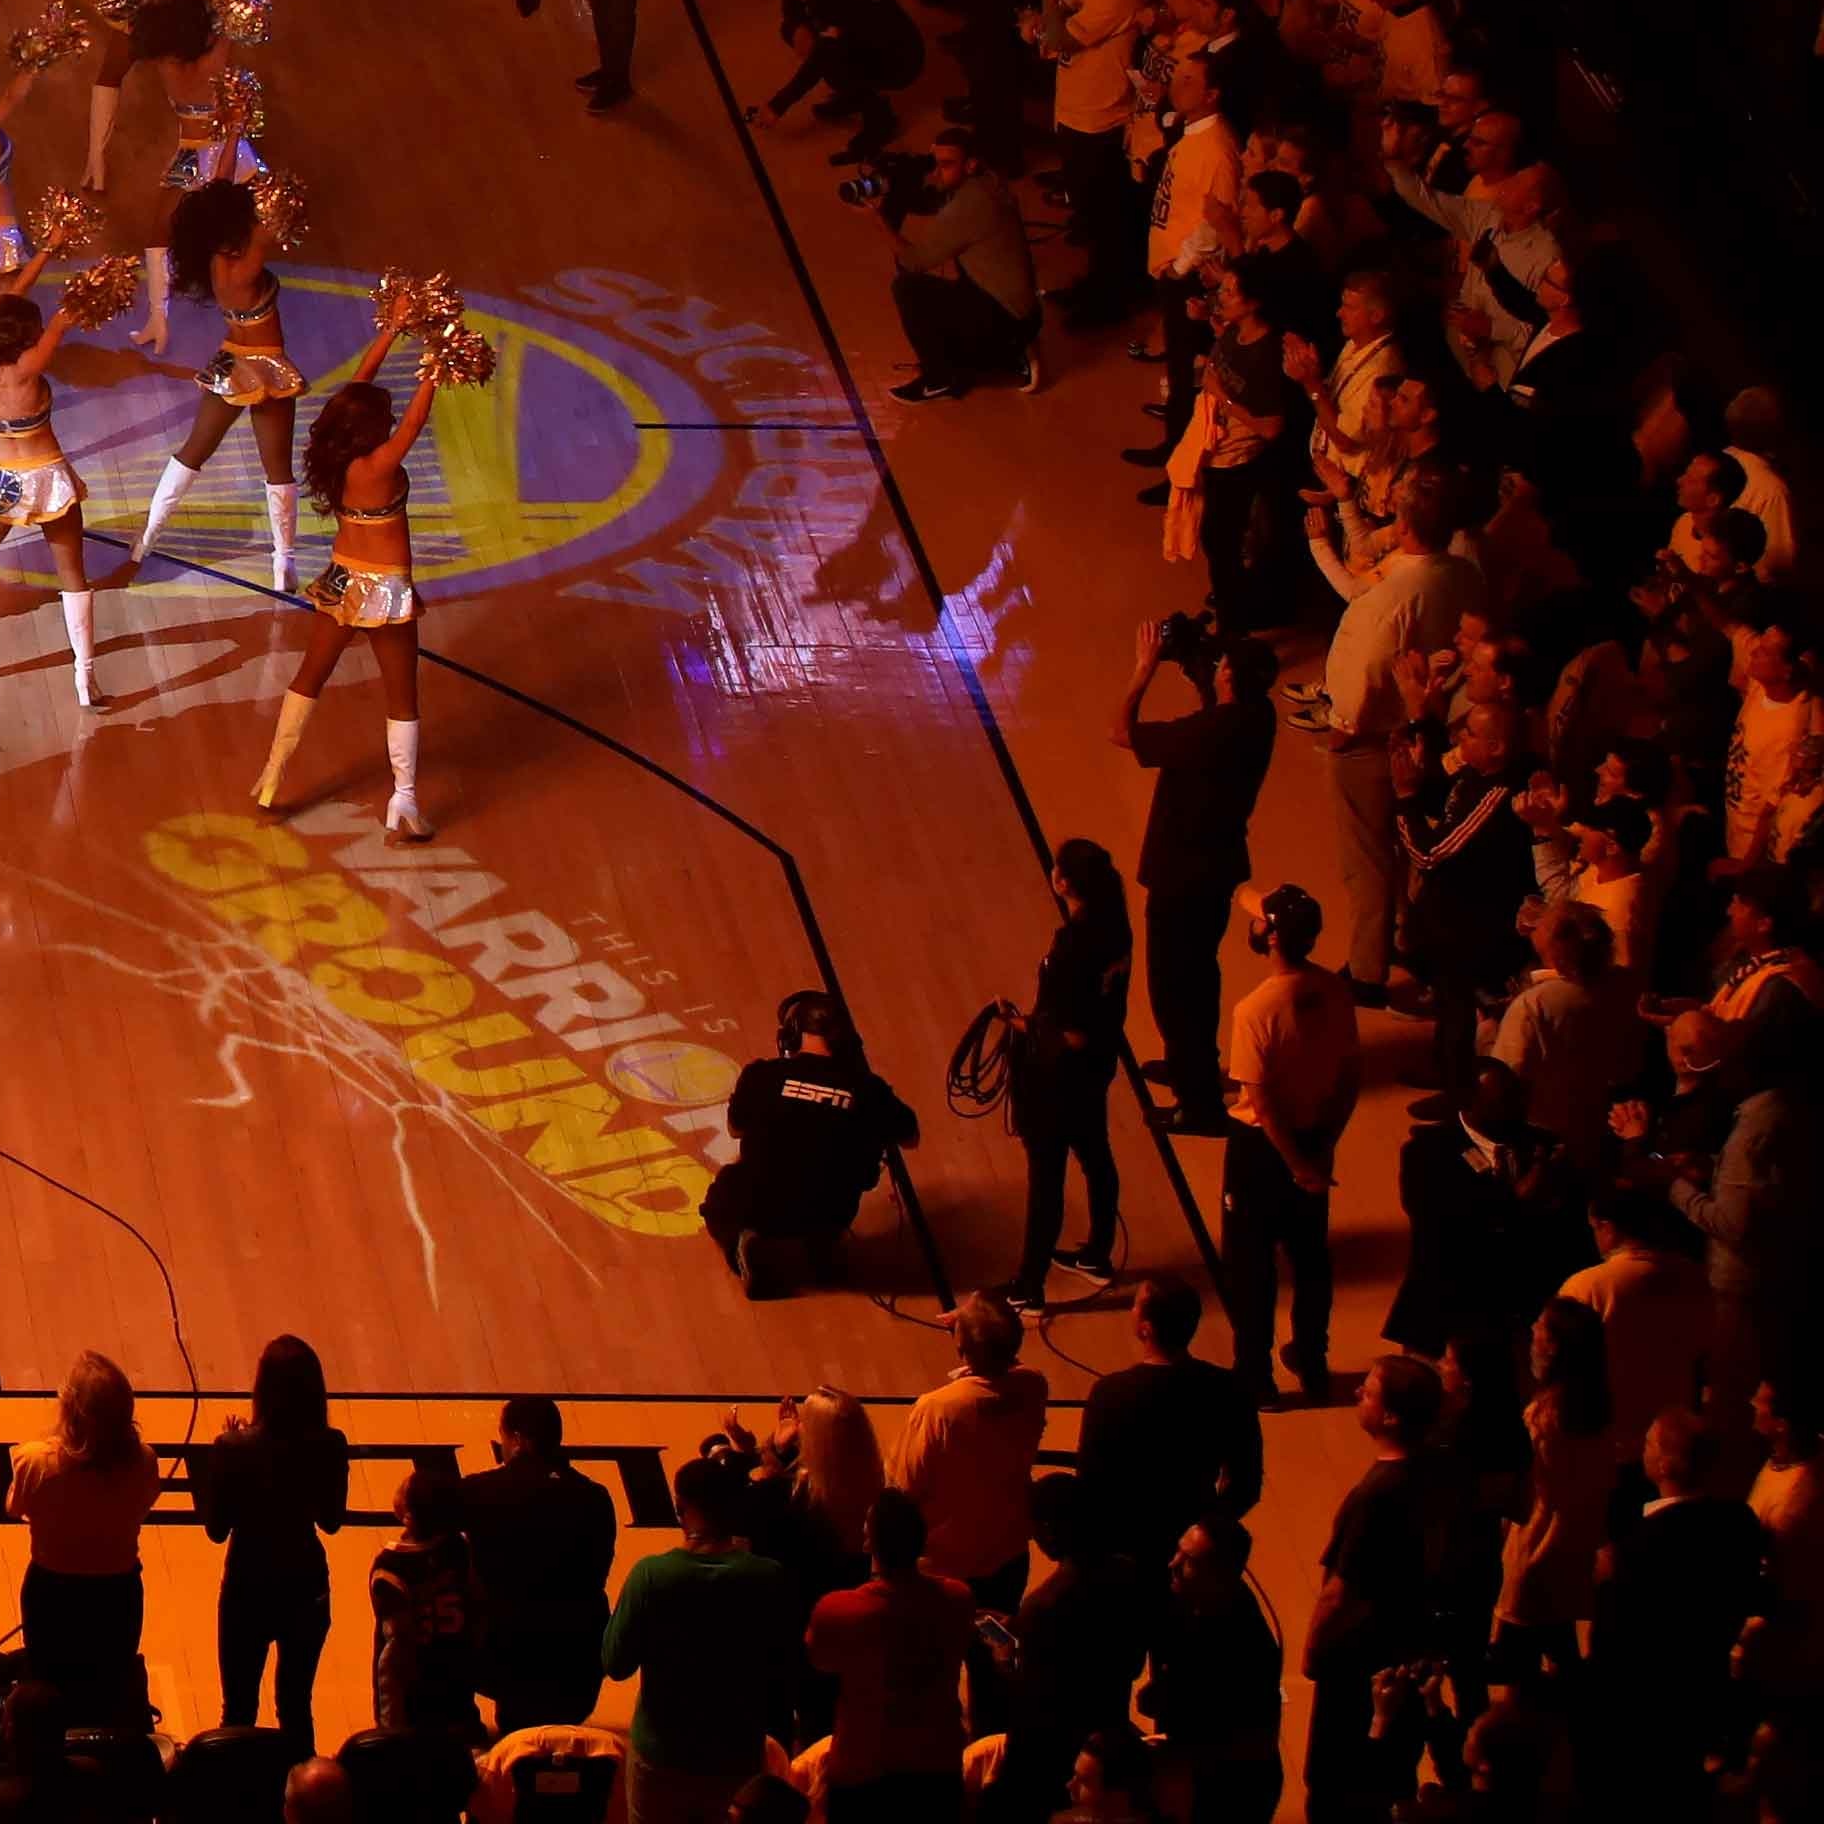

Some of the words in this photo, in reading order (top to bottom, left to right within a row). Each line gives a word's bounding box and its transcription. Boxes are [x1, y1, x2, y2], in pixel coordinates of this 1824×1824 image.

[143, 812, 716, 1238] GROUND
[280, 800, 741, 1166] WARRIO
[572, 911, 680, 987] THIS
[683, 1002, 741, 1037] IS
[781, 1078, 853, 1111] ESPN
